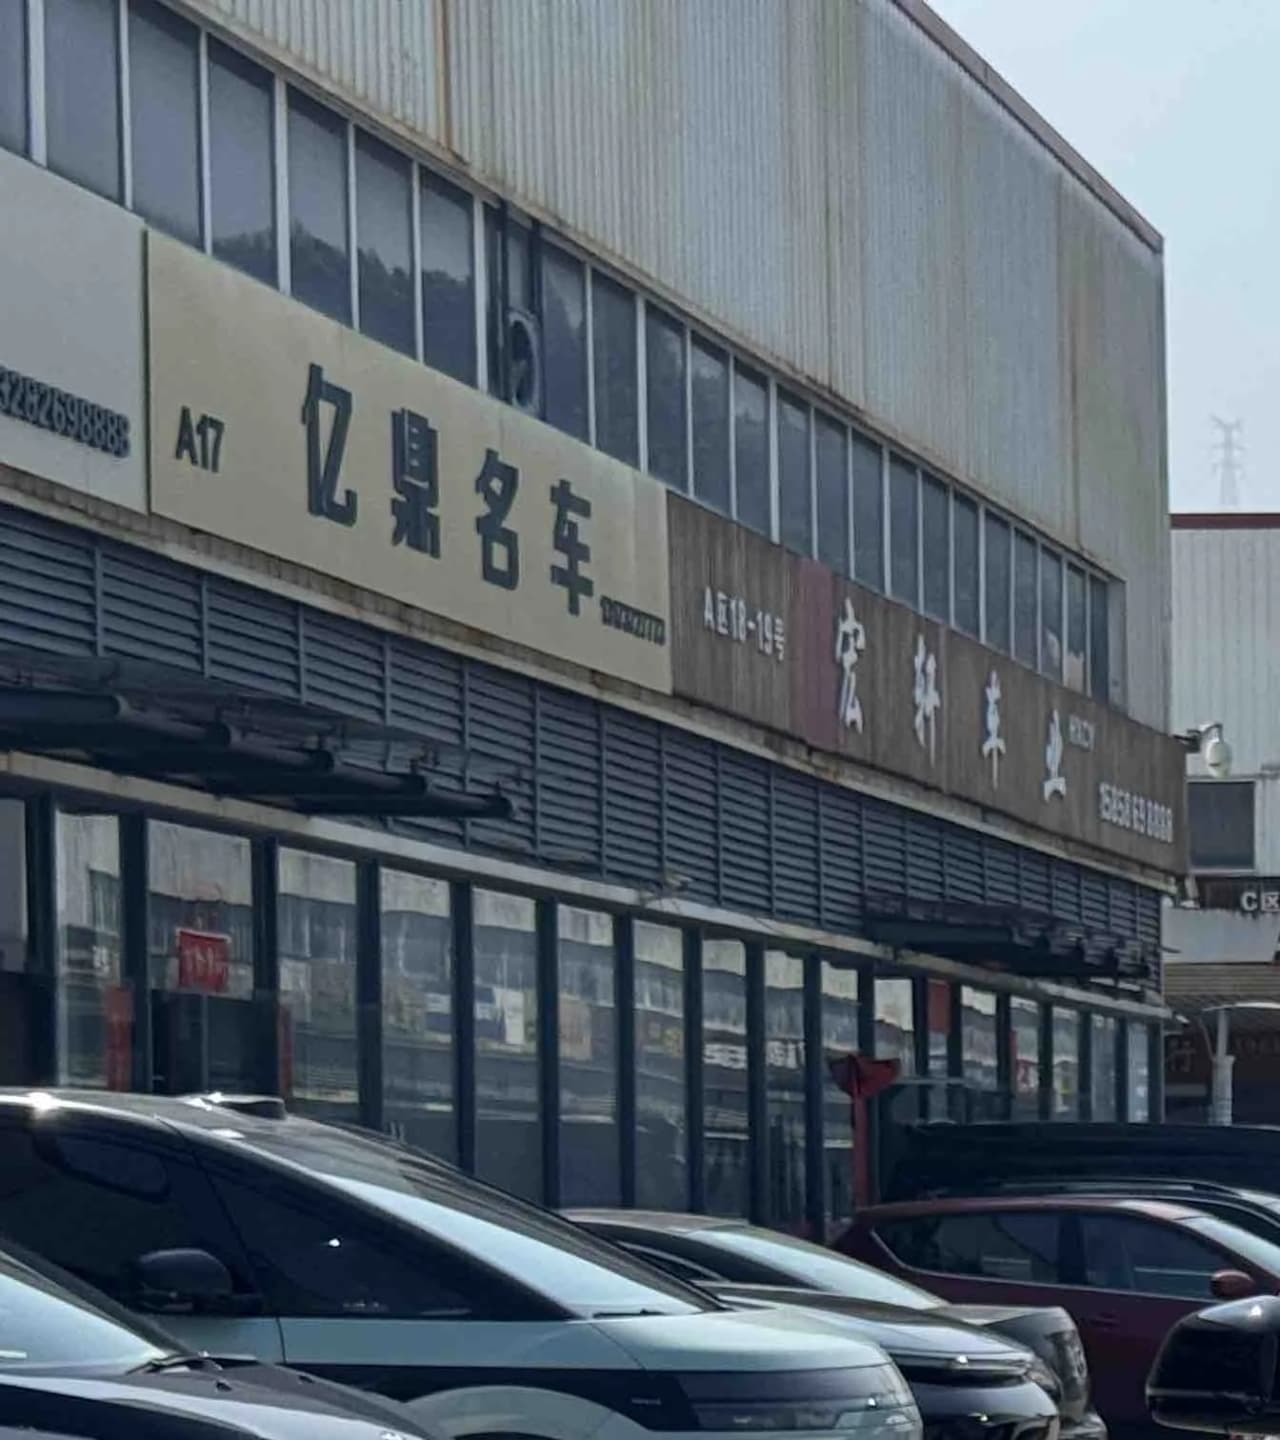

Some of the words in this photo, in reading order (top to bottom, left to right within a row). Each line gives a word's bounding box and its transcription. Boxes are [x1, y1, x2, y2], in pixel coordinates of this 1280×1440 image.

[174, 405, 225, 473] A17
[300, 362, 594, 617] 亿鼎名车
